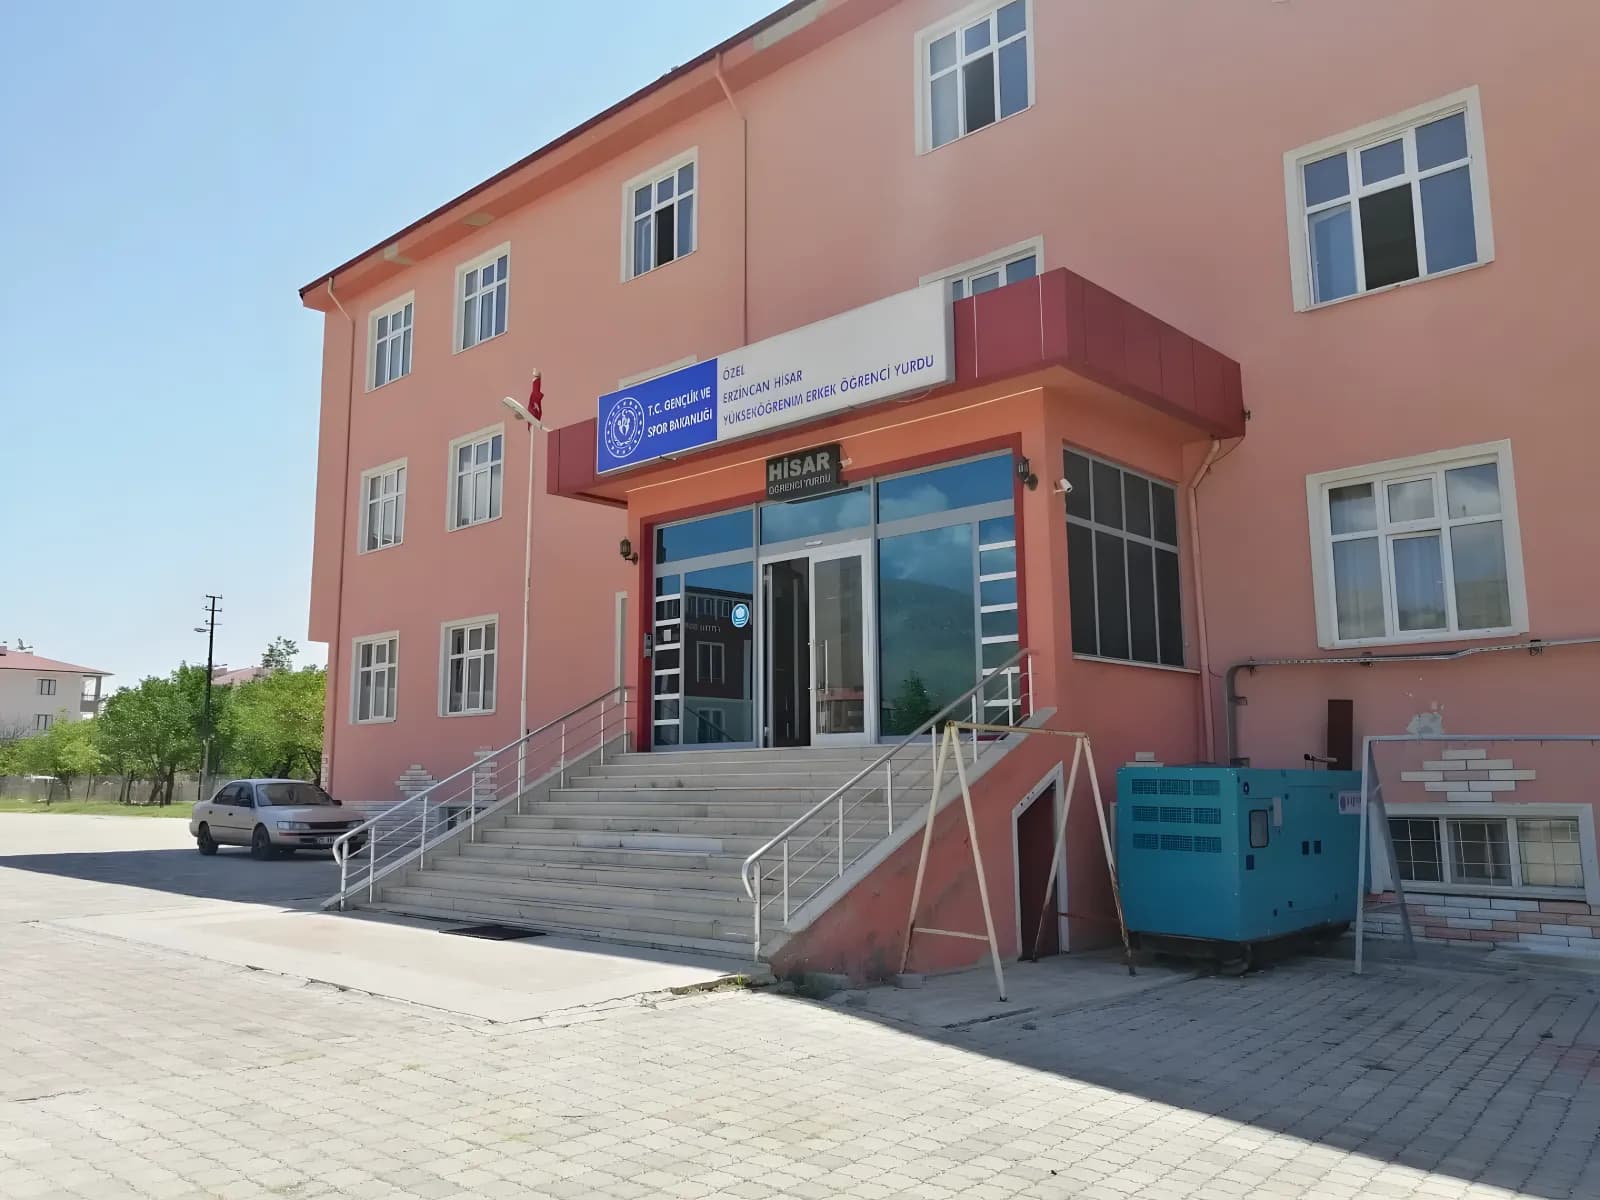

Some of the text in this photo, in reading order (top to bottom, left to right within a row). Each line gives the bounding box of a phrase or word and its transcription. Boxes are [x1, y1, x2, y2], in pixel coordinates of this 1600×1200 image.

[722, 363, 745, 380] ÖZEL
[723, 369, 803, 403] ERZİNCAN HİSAR
[806, 383, 836, 403] ERKEK
[840, 364, 890, 392] ÖĞRENCİ
[894, 353, 934, 377] YURDU
[647, 386, 711, 416] T.C. GENÇLİK VE
[647, 407, 713, 438] SPOR BAKANLIĞI
[768, 451, 831, 482] HİSAR
